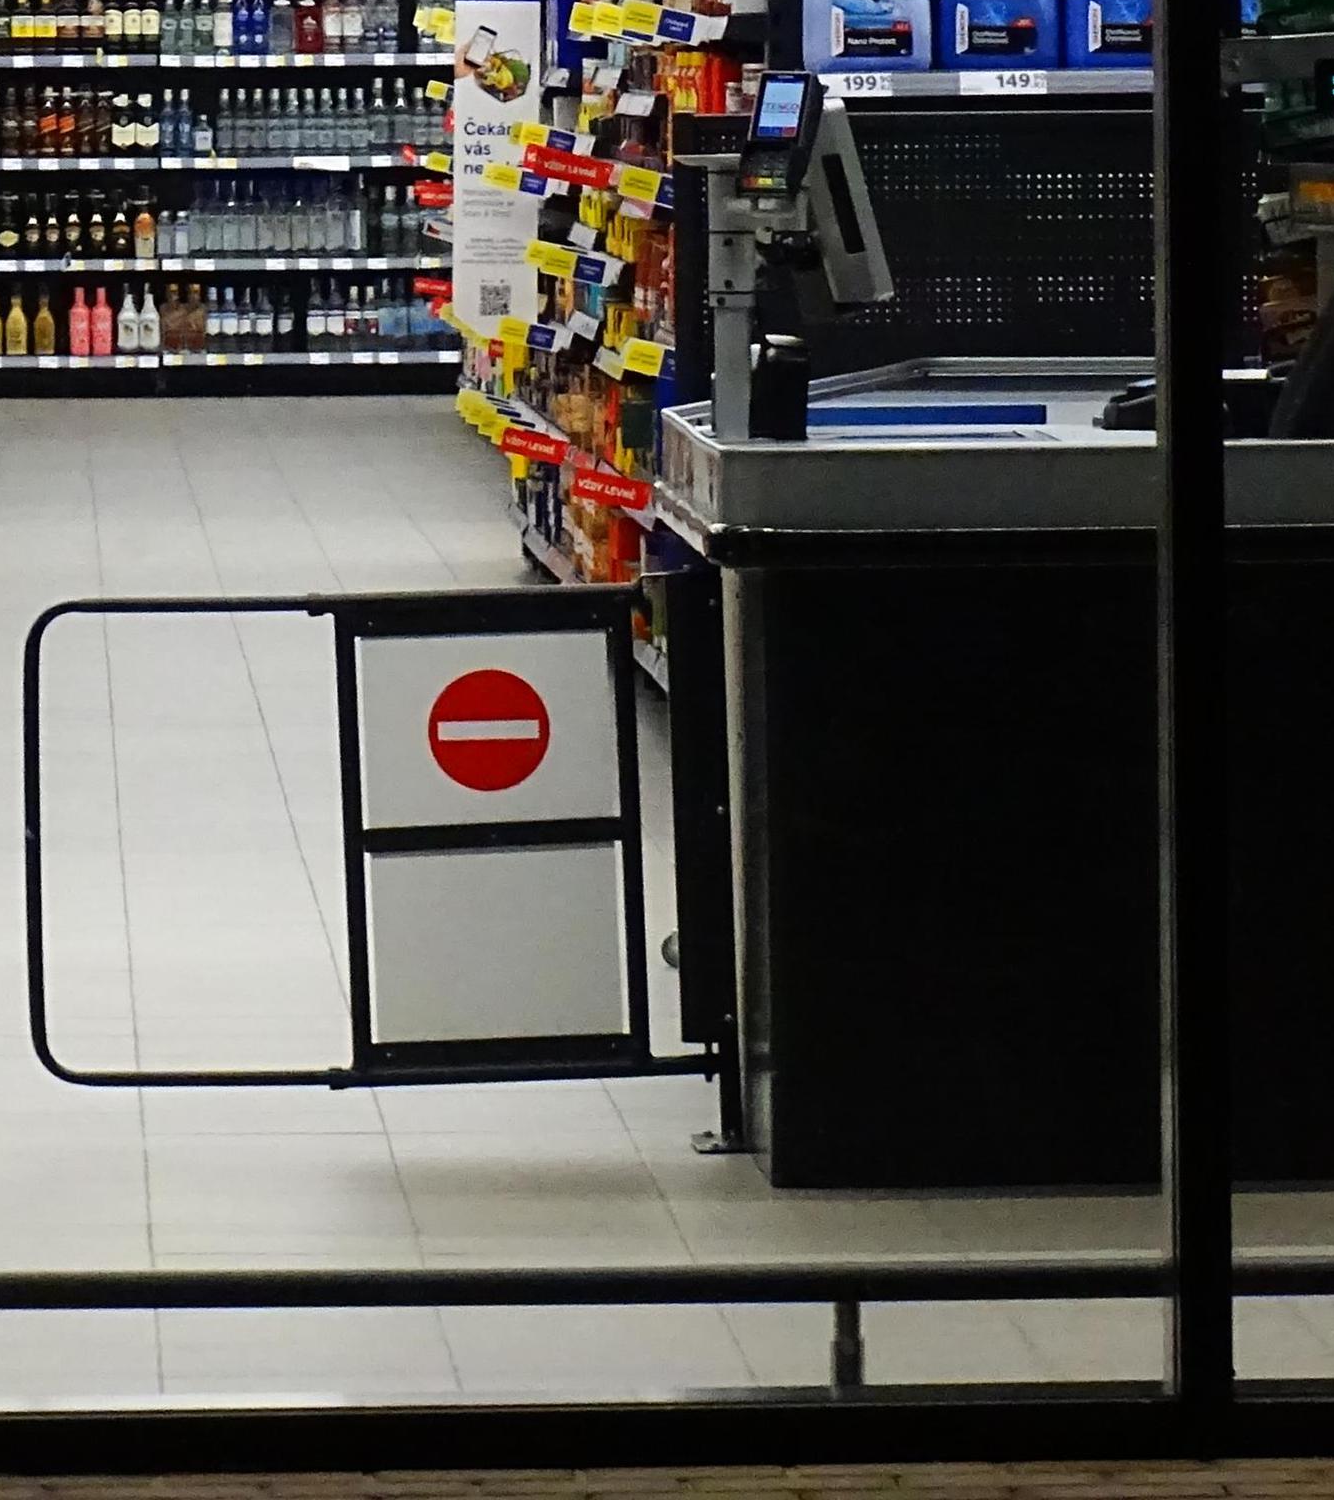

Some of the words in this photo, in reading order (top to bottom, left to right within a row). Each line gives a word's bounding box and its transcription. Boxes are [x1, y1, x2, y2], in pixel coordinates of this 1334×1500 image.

[843, 75, 877, 91] 199
[996, 73, 1030, 88] 149
[464, 141, 491, 156] vás
